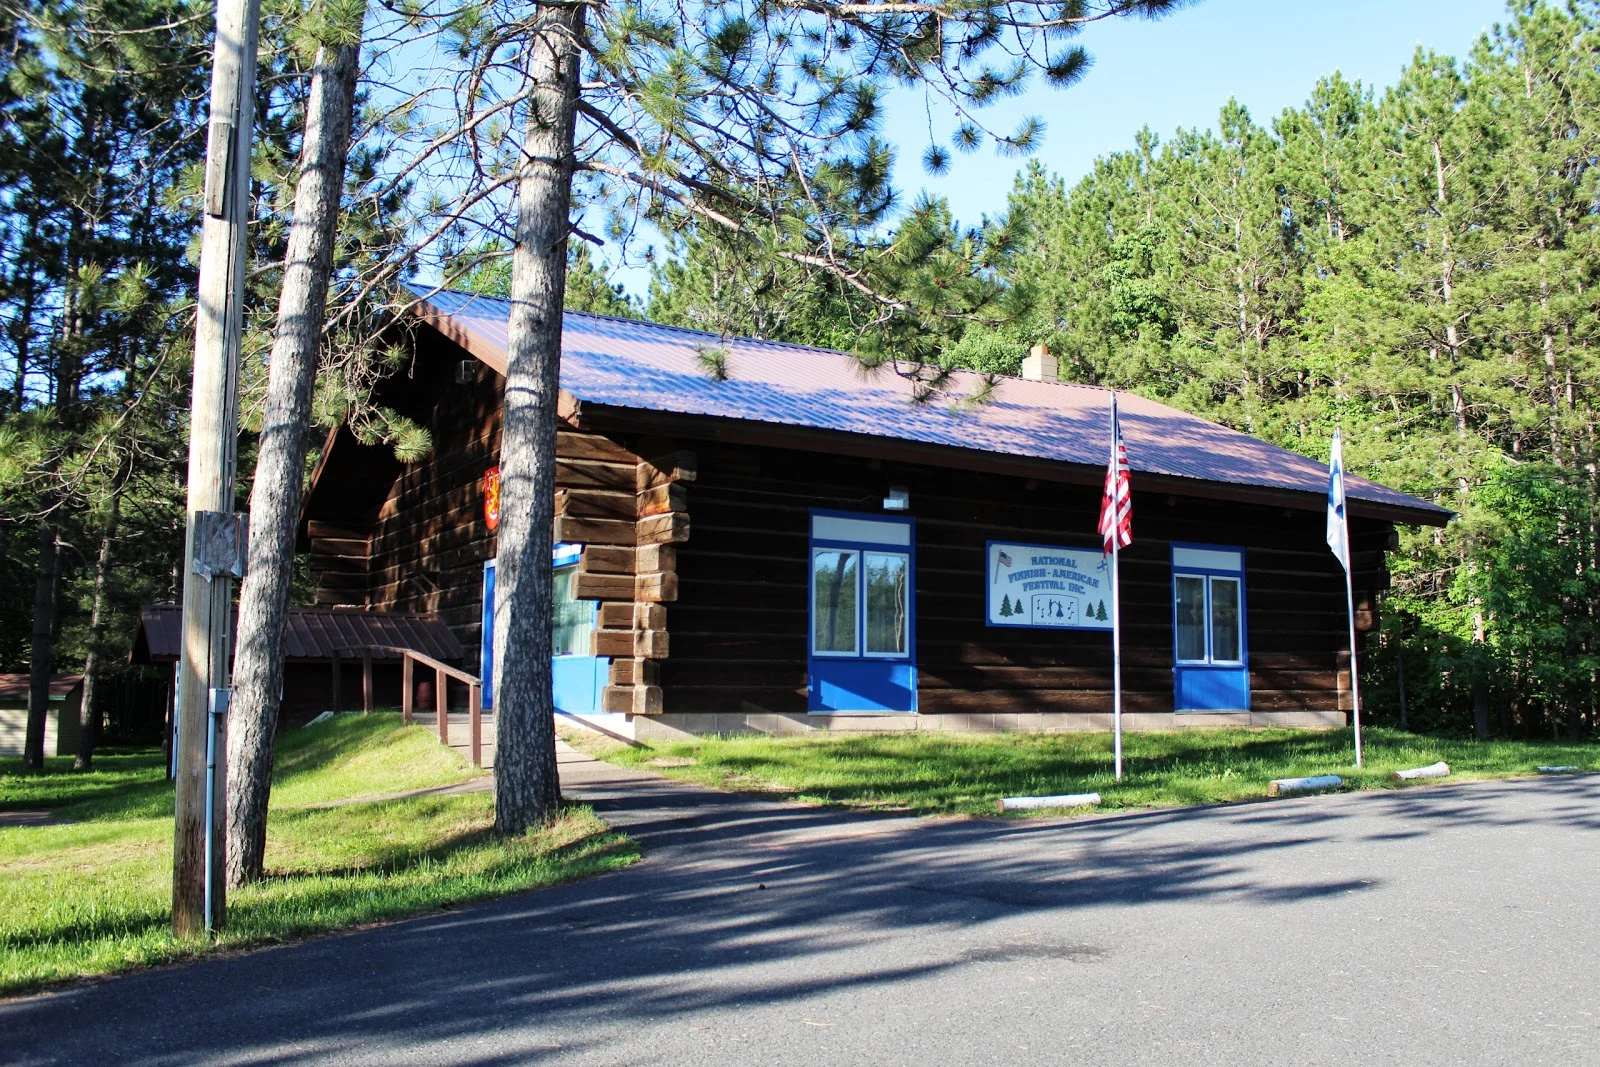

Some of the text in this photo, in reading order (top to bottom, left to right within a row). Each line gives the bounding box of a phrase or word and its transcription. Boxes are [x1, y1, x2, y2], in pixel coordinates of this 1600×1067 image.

[1031, 556, 1077, 569] NATIONAL
[1008, 568, 1046, 583] FINNISH
[1052, 569, 1099, 588] AMERICAN
[1022, 580, 1086, 595] FESTIVAL INC.
